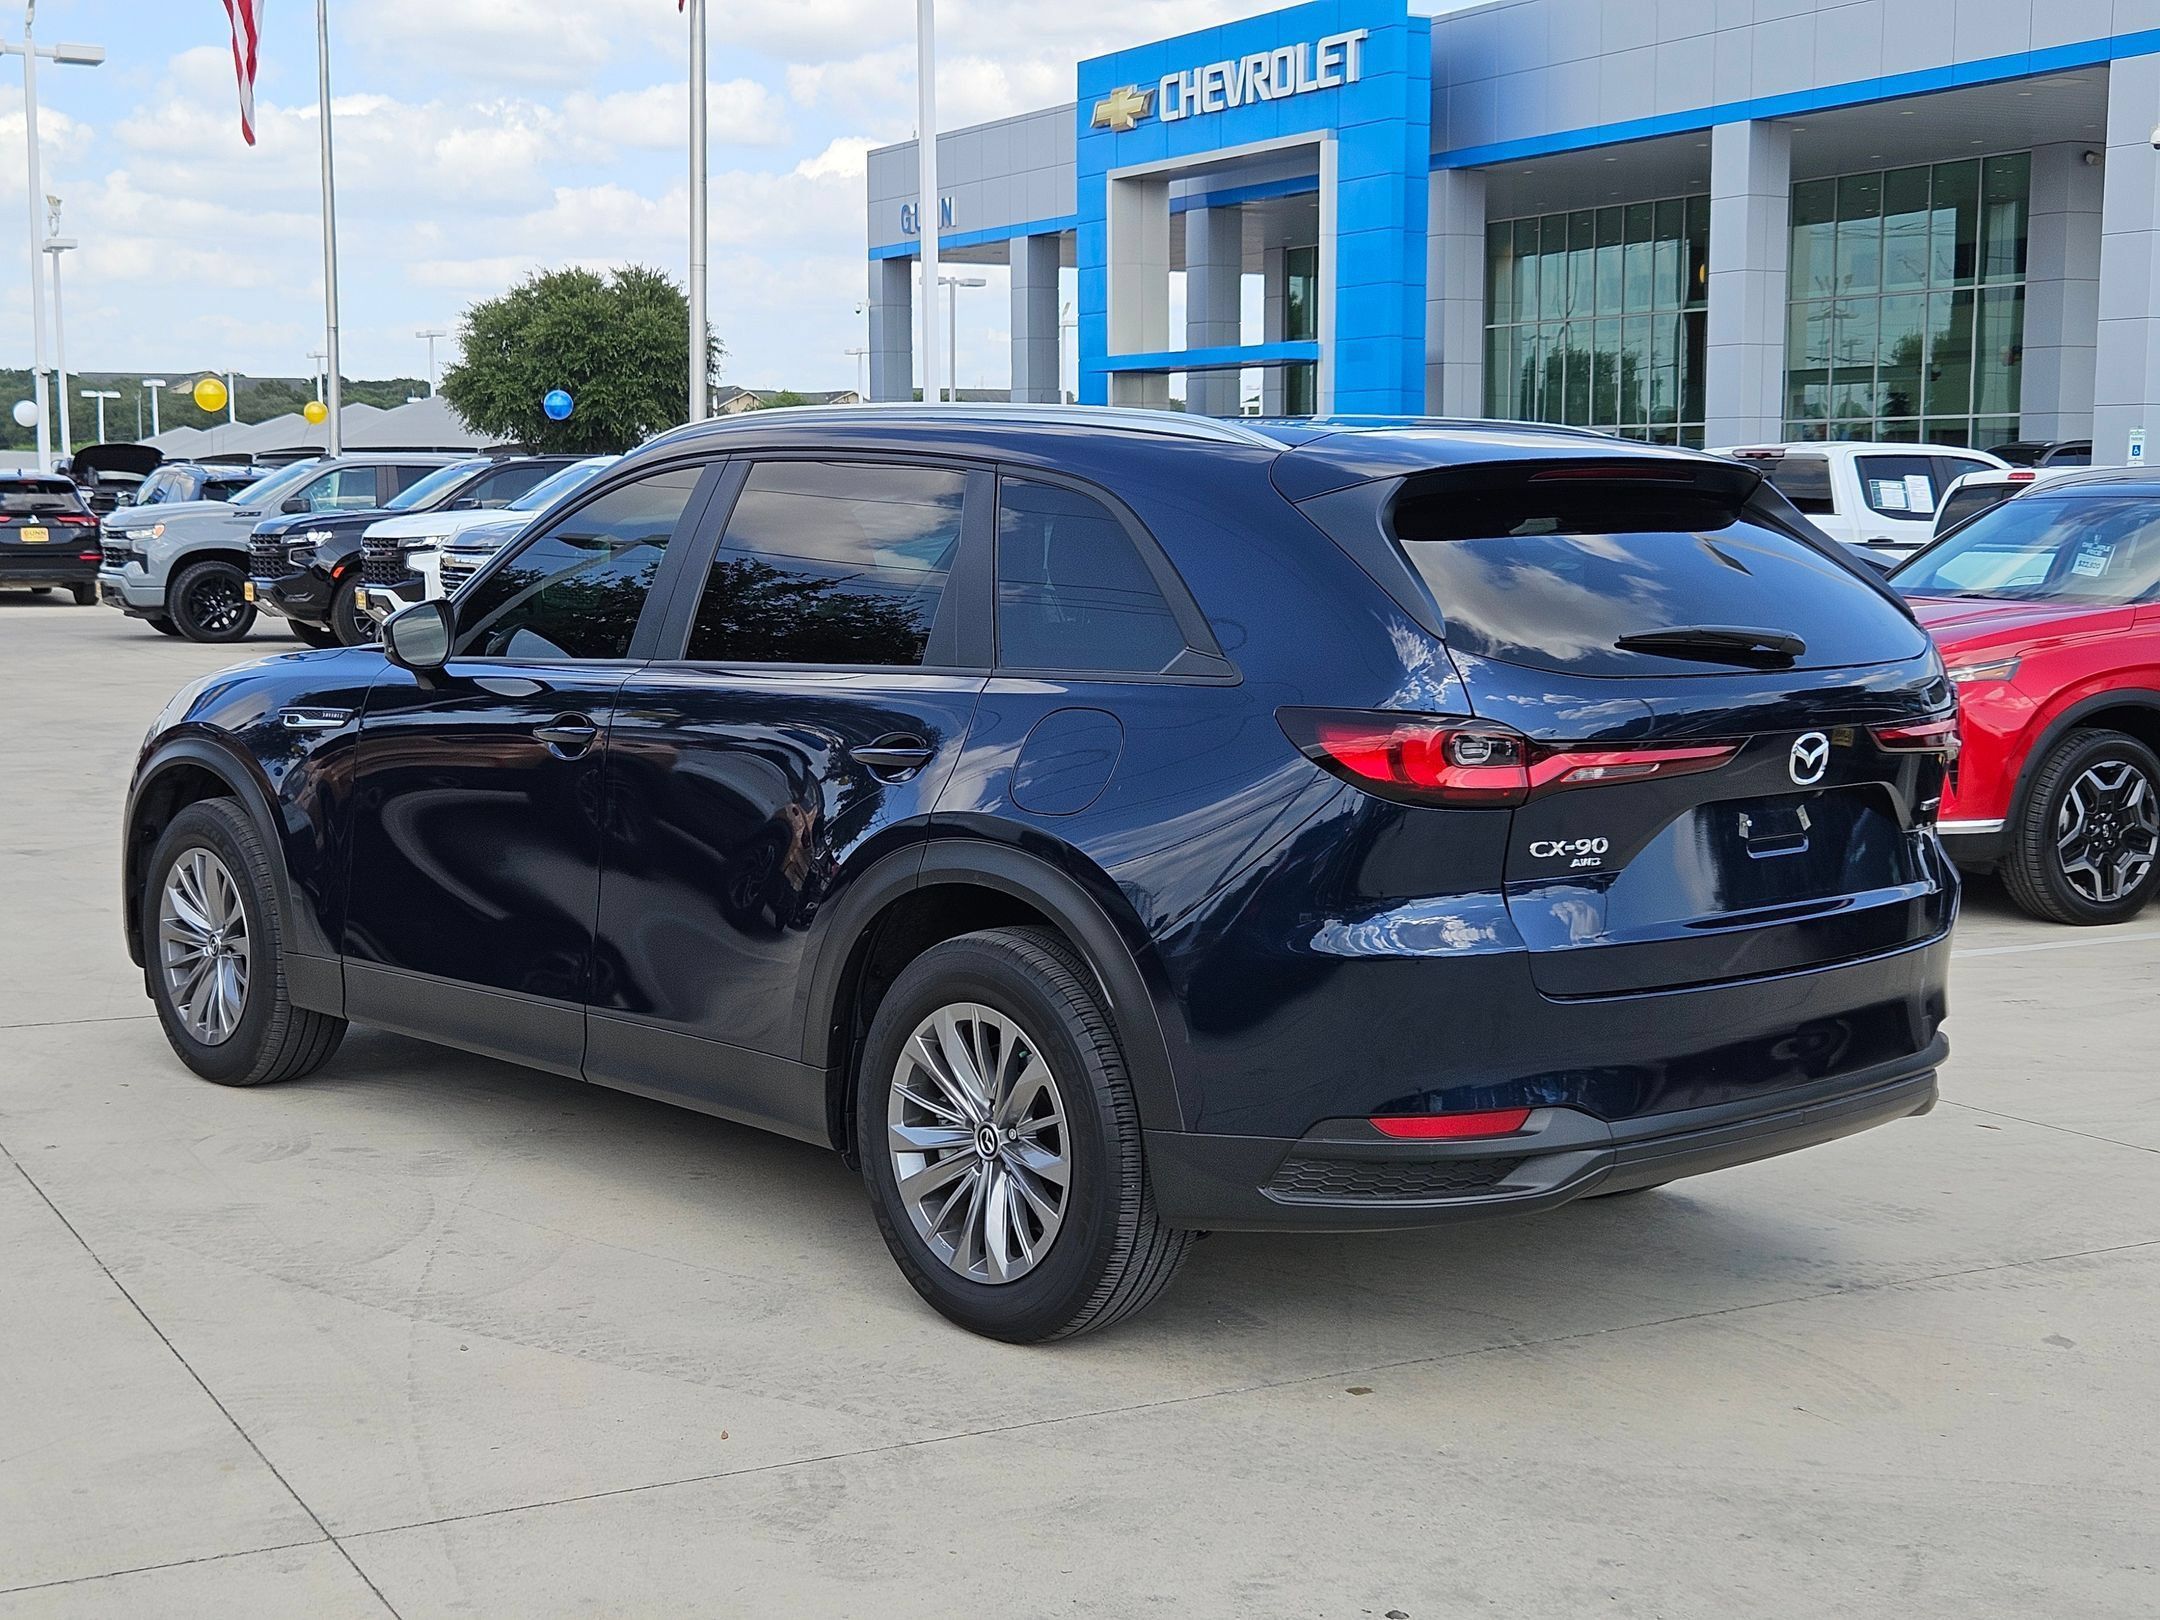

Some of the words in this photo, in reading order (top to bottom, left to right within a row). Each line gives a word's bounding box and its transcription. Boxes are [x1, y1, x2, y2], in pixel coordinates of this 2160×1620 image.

[1159, 28, 1369, 122] CHEVROLET
[901, 197, 957, 234] GUN
[1529, 837, 1609, 858] CX-90
[1569, 857, 1602, 868] AWD
